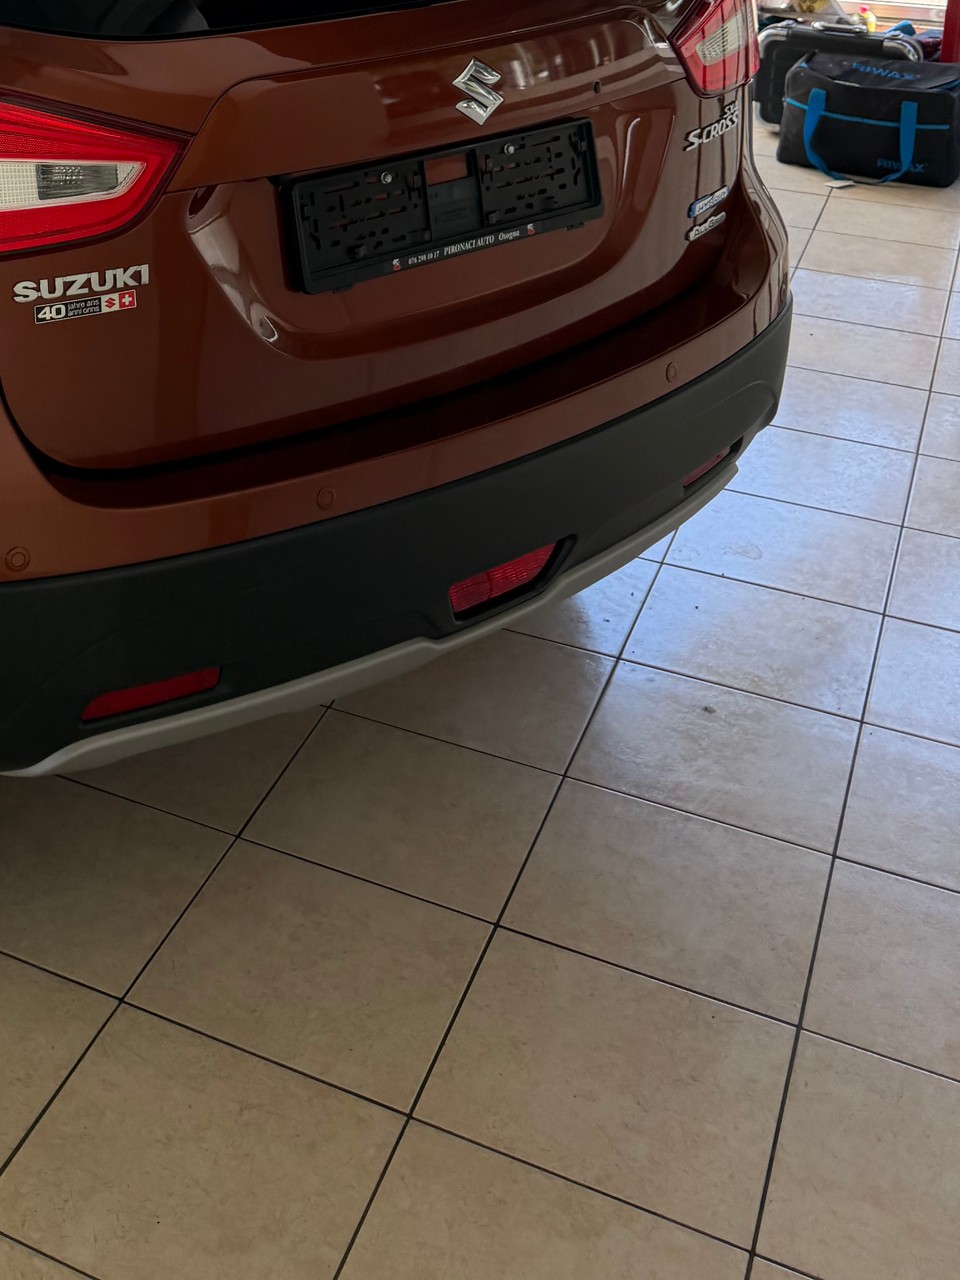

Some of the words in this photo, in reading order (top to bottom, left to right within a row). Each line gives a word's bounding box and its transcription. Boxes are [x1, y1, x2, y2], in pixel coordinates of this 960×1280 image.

[851, 62, 915, 80] RIWAX
[443, 239, 476, 256] PIRONACI
[476, 234, 495, 247] AUTO
[13, 264, 150, 303] SUZUKI
[37, 304, 66, 321] 40
